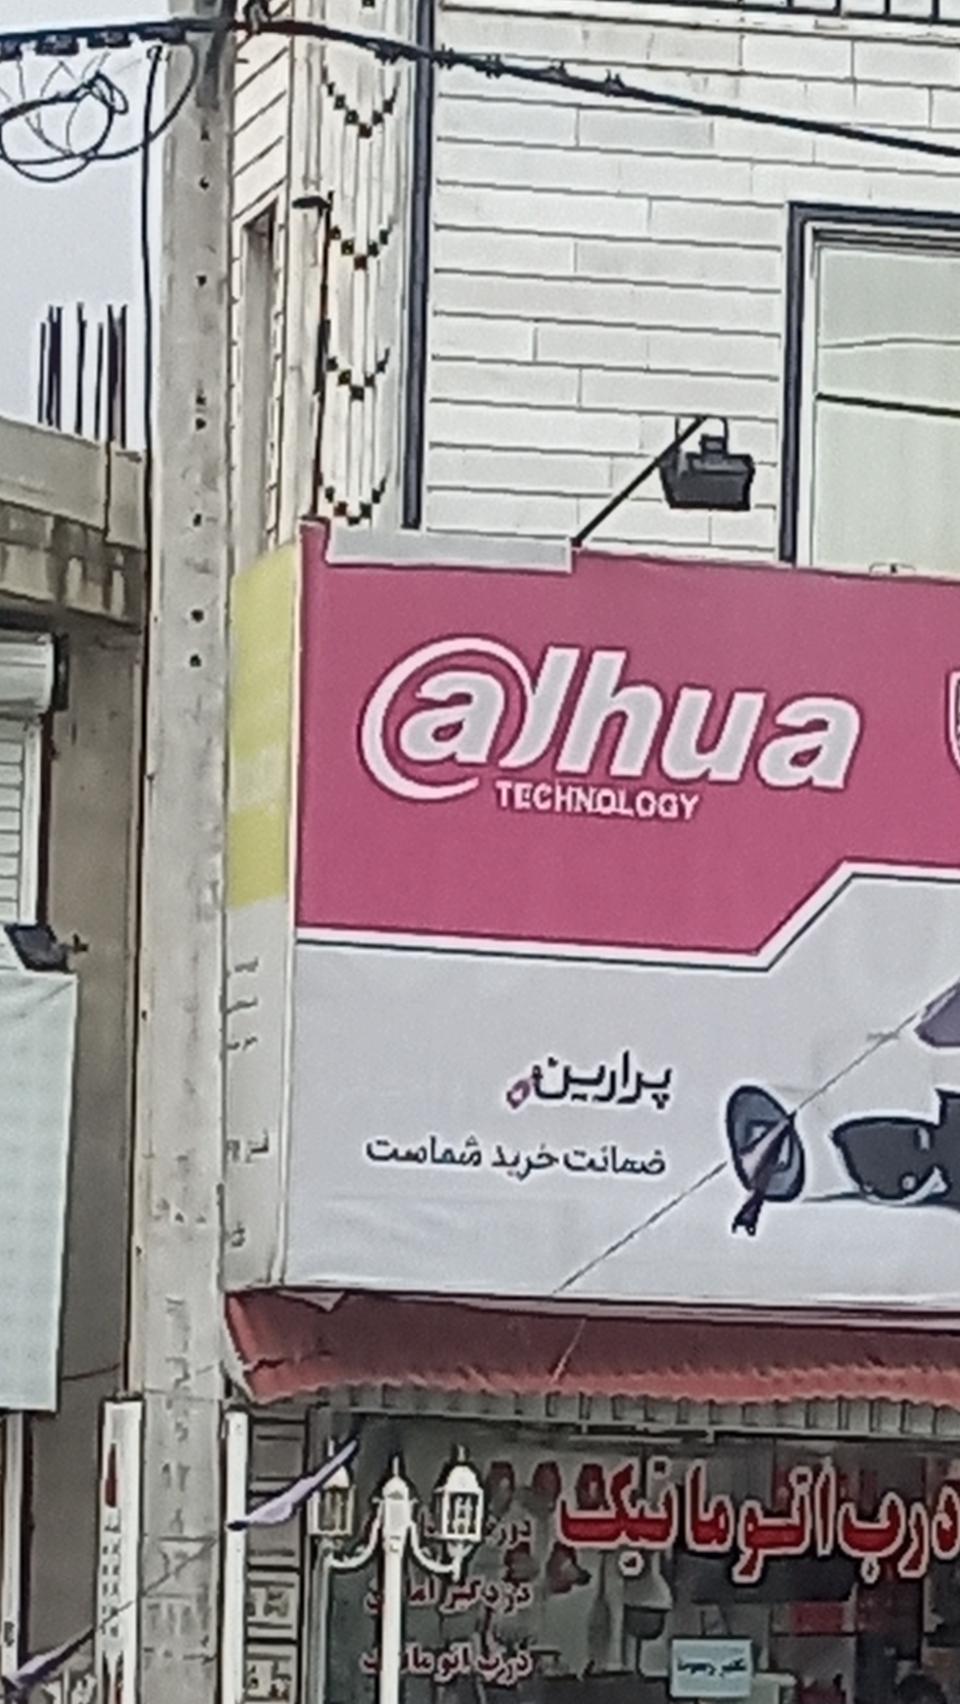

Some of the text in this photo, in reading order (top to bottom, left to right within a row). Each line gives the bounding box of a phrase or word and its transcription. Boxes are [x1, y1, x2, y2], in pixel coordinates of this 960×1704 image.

[495, 778, 699, 820] TECHNOLOGY
[366, 1134, 666, 1180] ضمانت خرید شماست
